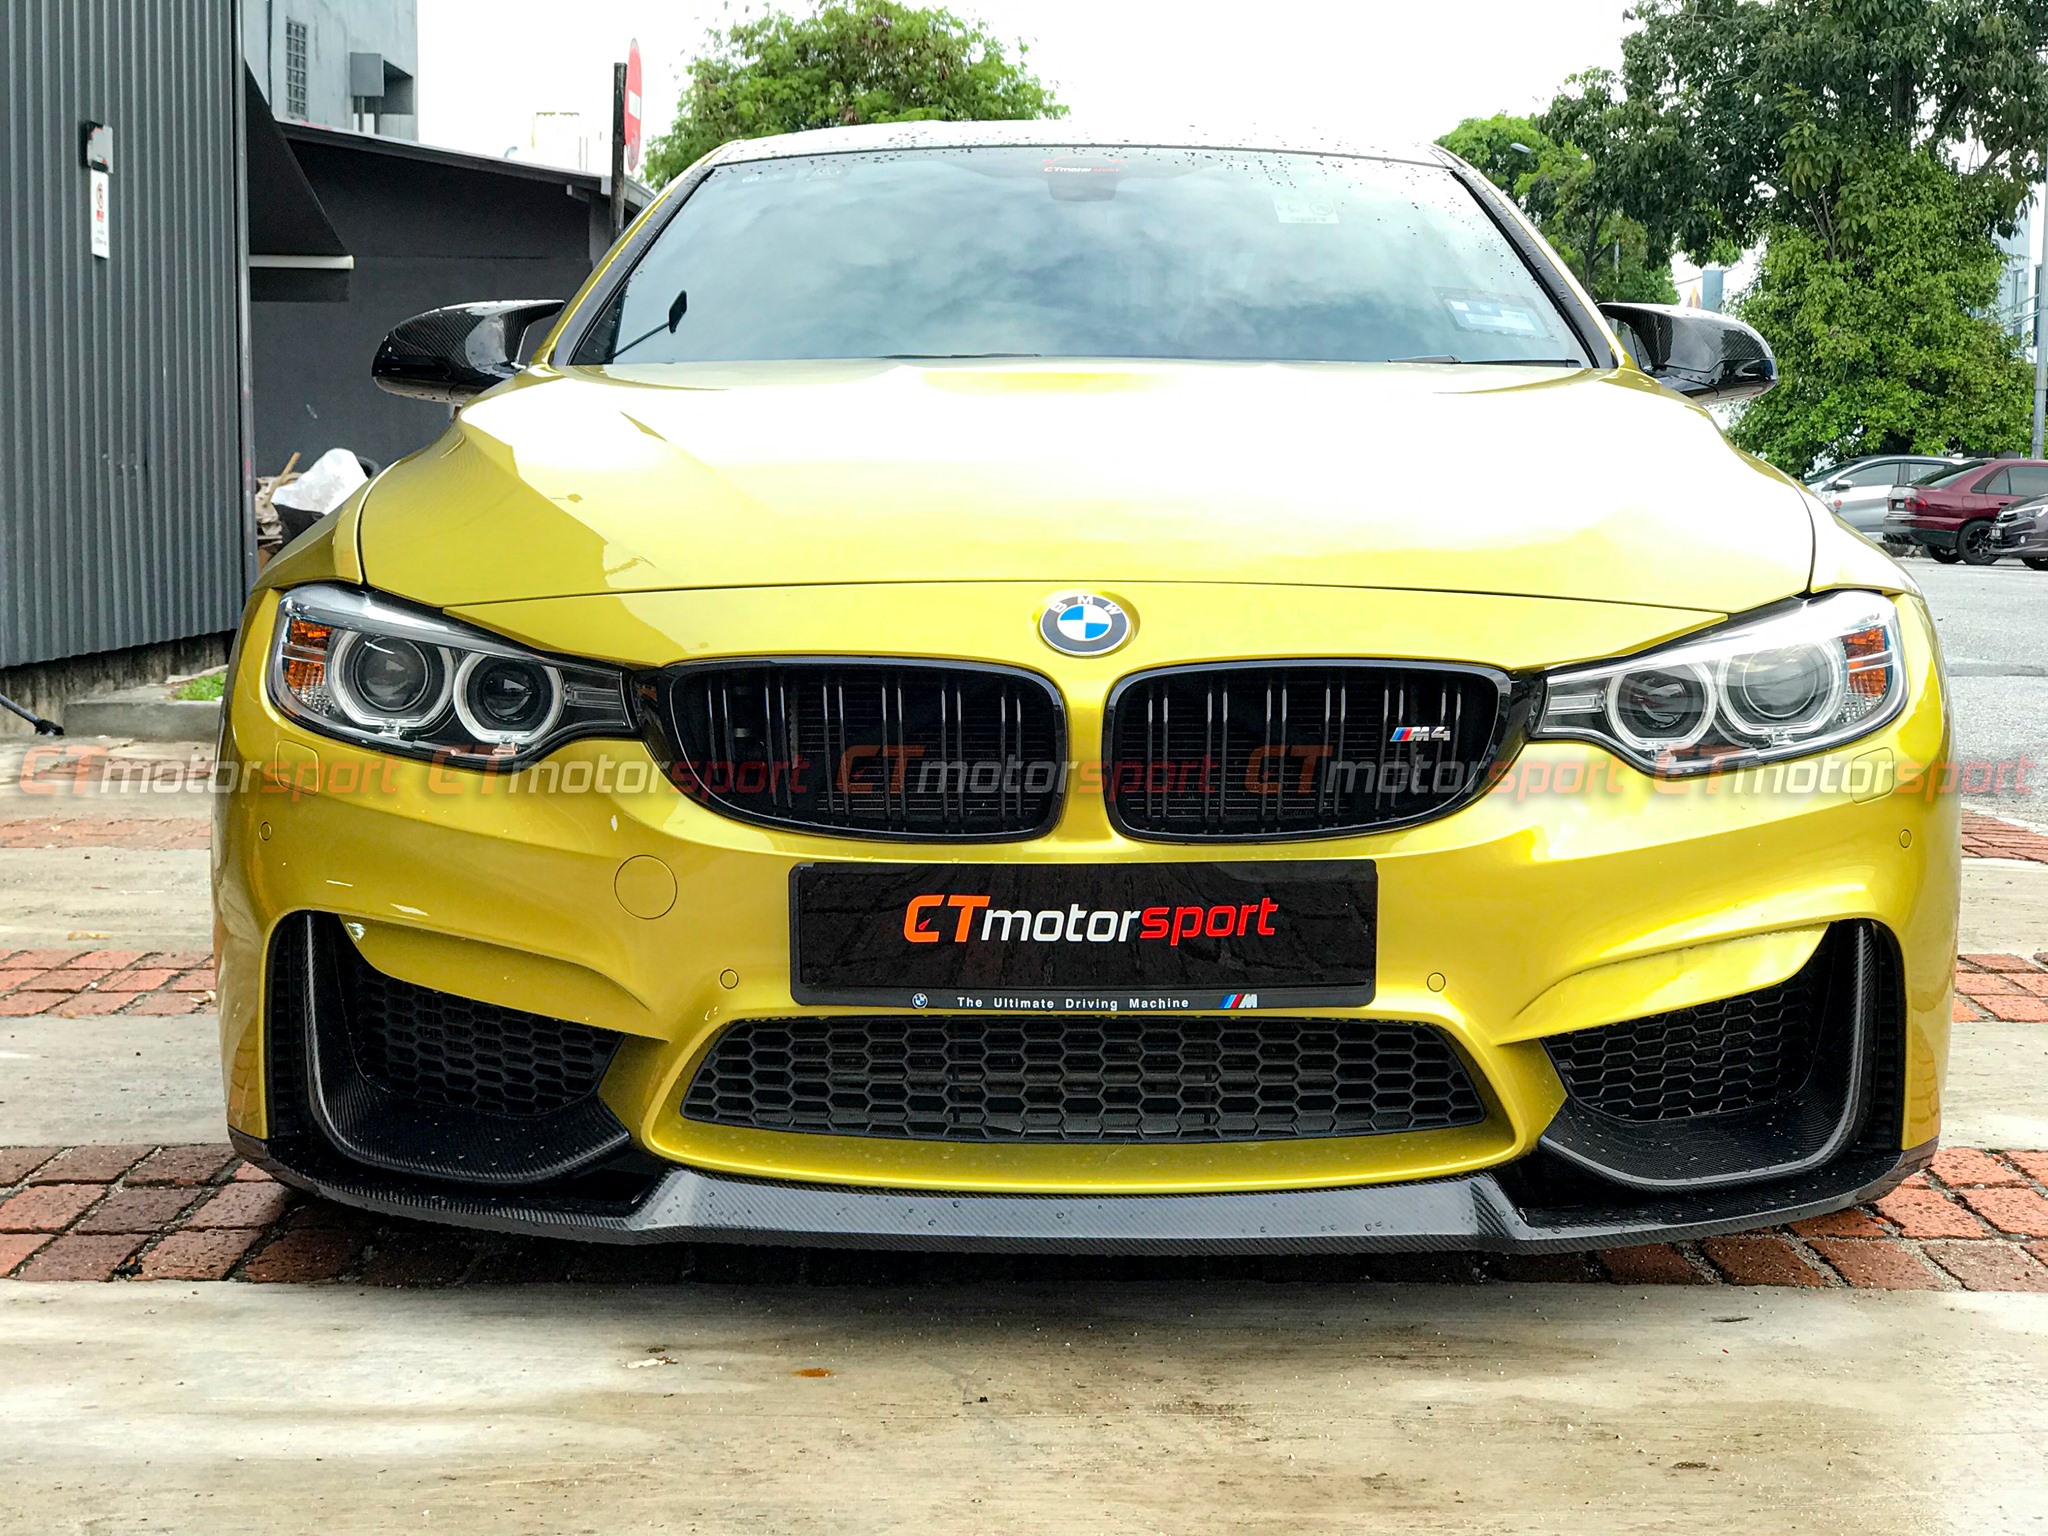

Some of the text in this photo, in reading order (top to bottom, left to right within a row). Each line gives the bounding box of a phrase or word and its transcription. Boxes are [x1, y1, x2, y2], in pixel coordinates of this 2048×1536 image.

[1049, 595, 1121, 615] BMW
[1410, 726, 1451, 741] M4
[903, 894, 1279, 946] CTmotorsport
[957, 997, 1189, 1012] The Ultimate Driving Machine
